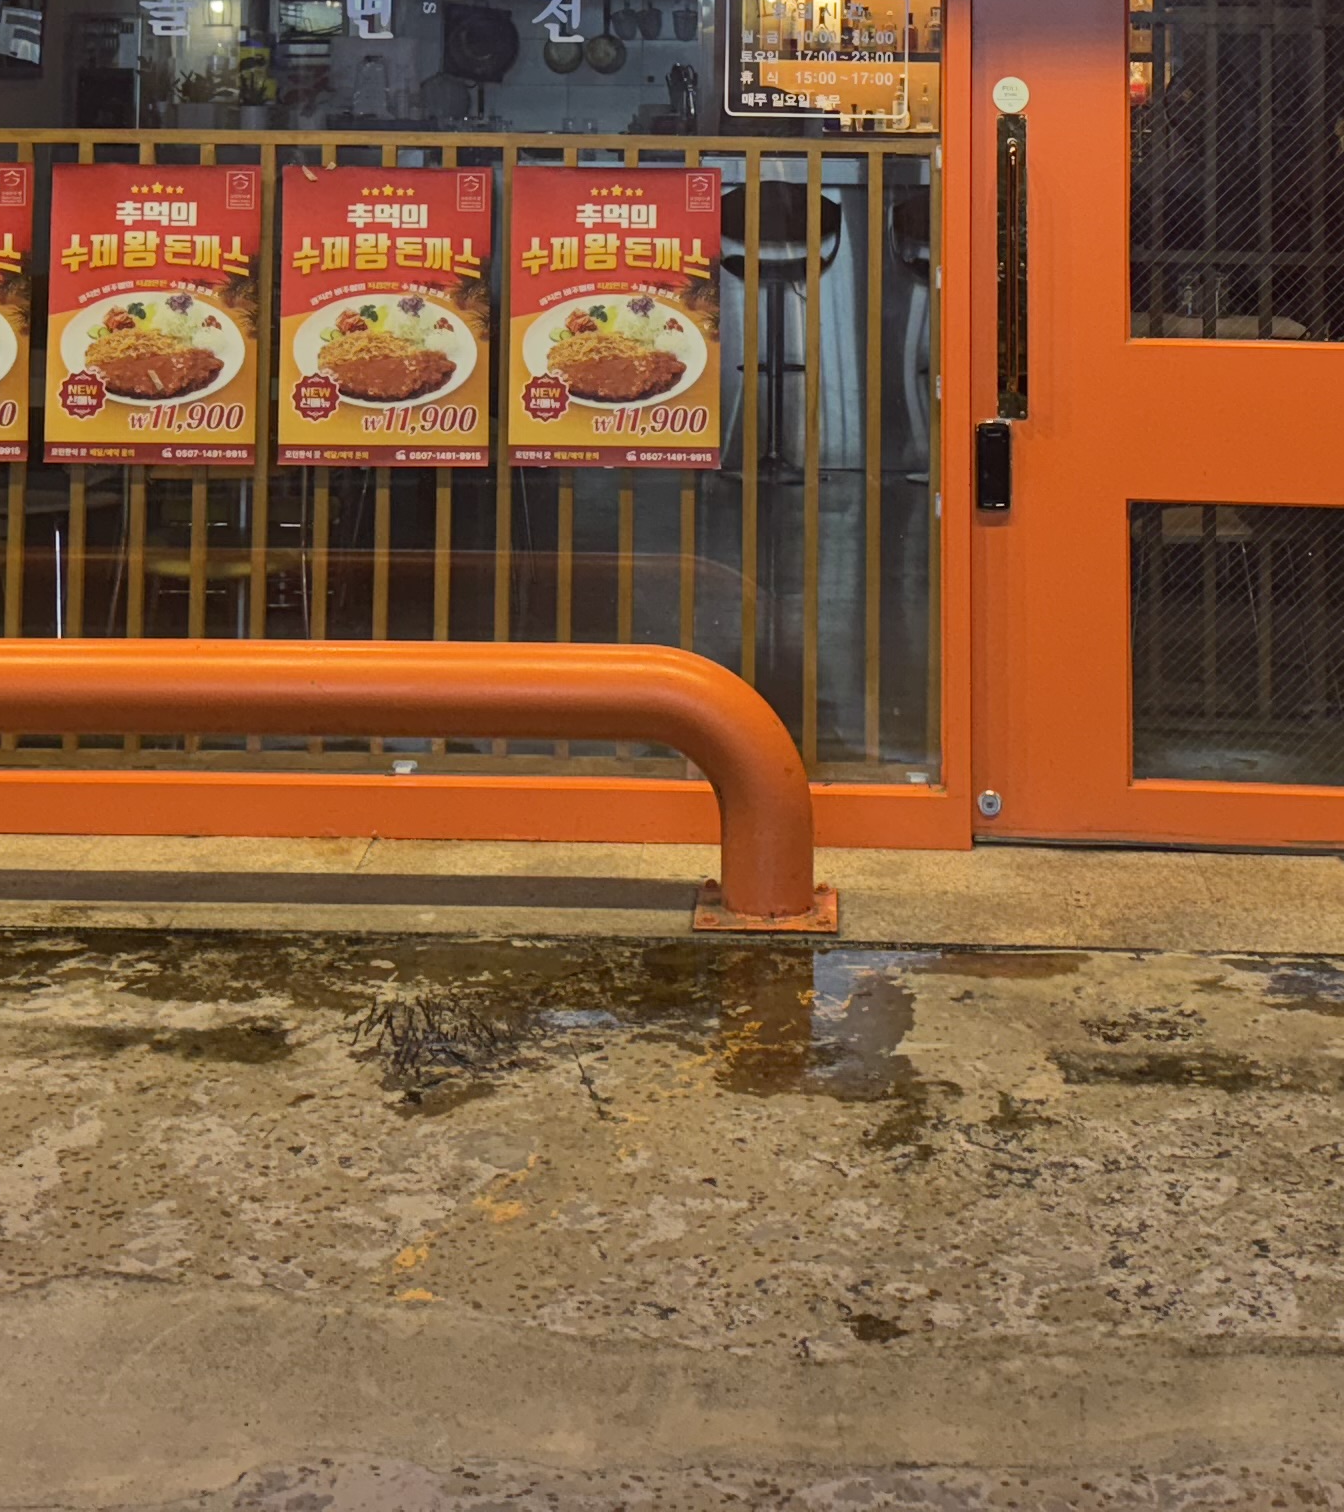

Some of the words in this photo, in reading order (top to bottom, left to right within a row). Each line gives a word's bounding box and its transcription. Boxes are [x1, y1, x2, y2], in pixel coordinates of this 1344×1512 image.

[740, 51, 778, 63] 토요일
[741, 92, 768, 107] 매주
[772, 92, 810, 108] 일요일
[116, 201, 197, 226] 추억의
[347, 203, 428, 229] 추억의
[576, 203, 657, 229] 추억의
[61, 234, 118, 273] 수제
[123, 230, 160, 268] 왕
[164, 235, 250, 277] 돈까스
[292, 236, 350, 275] 수제
[355, 233, 391, 270] 왕
[395, 237, 481, 279] 돈까스
[521, 237, 579, 275] 수제
[584, 233, 620, 270] 왕
[624, 238, 710, 279] 돈까스
[67, 384, 98, 396] NEW
[301, 386, 331, 398] NEW
[530, 386, 560, 398] NEW
